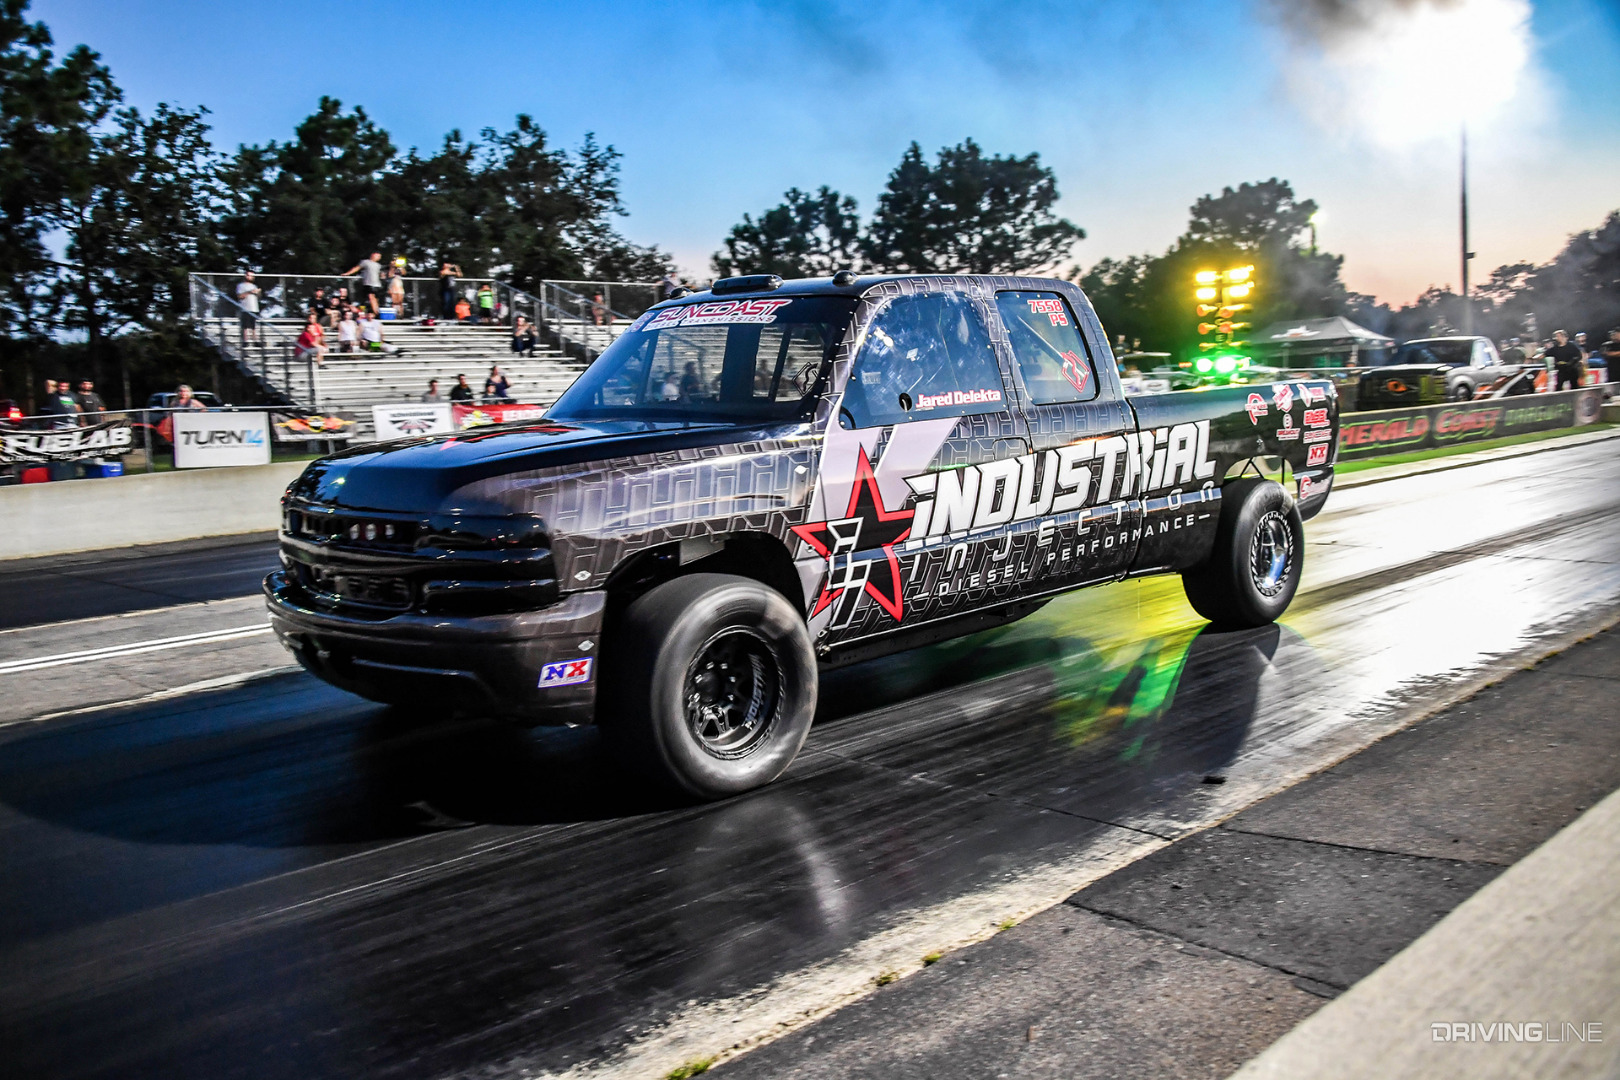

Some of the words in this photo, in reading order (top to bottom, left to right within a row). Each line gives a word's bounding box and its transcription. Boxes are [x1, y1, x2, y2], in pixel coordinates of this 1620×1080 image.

[650, 300, 790, 324] SUNCOAST
[1027, 300, 1064, 314] 7558
[683, 314, 777, 324] TRANSMISSIONS
[1049, 313, 1069, 327] PS
[916, 391, 953, 408] Jared
[953, 388, 1002, 405] Delekta
[4, 427, 132, 454] FUELAB
[1310, 446, 1326, 460] NX
[938, 563, 1029, 597] DIESEL
[1046, 514, 1196, 566] PERFORMANCE
[544, 660, 588, 681] NX
